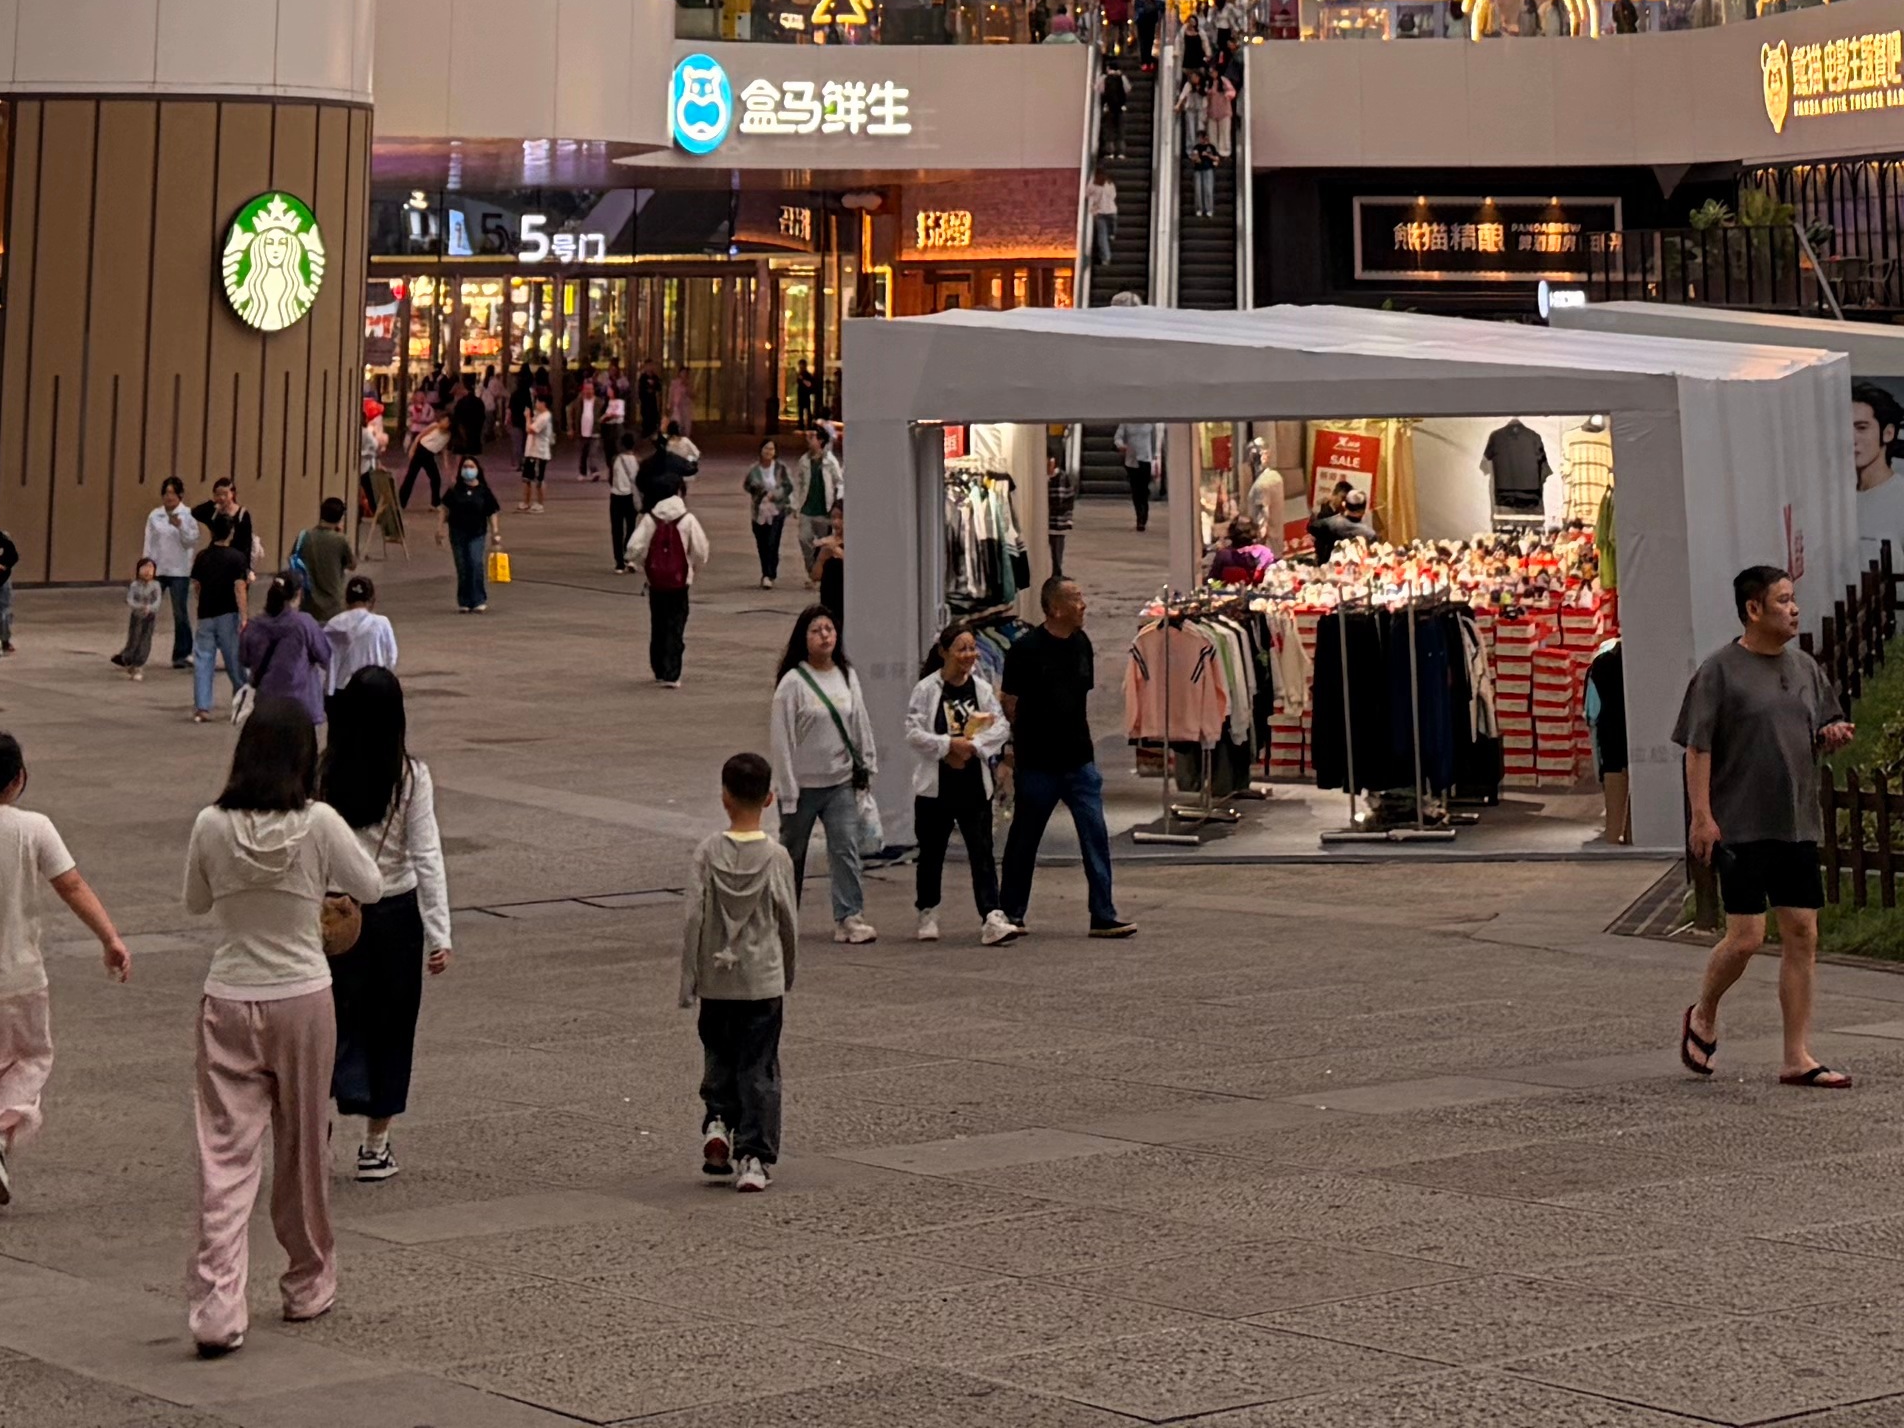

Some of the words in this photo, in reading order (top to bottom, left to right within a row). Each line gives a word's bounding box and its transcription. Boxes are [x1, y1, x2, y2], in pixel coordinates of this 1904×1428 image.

[739, 79, 912, 135] 盒马鲜生
[517, 214, 607, 263] 5号门
[1329, 455, 1361, 469] SALE
